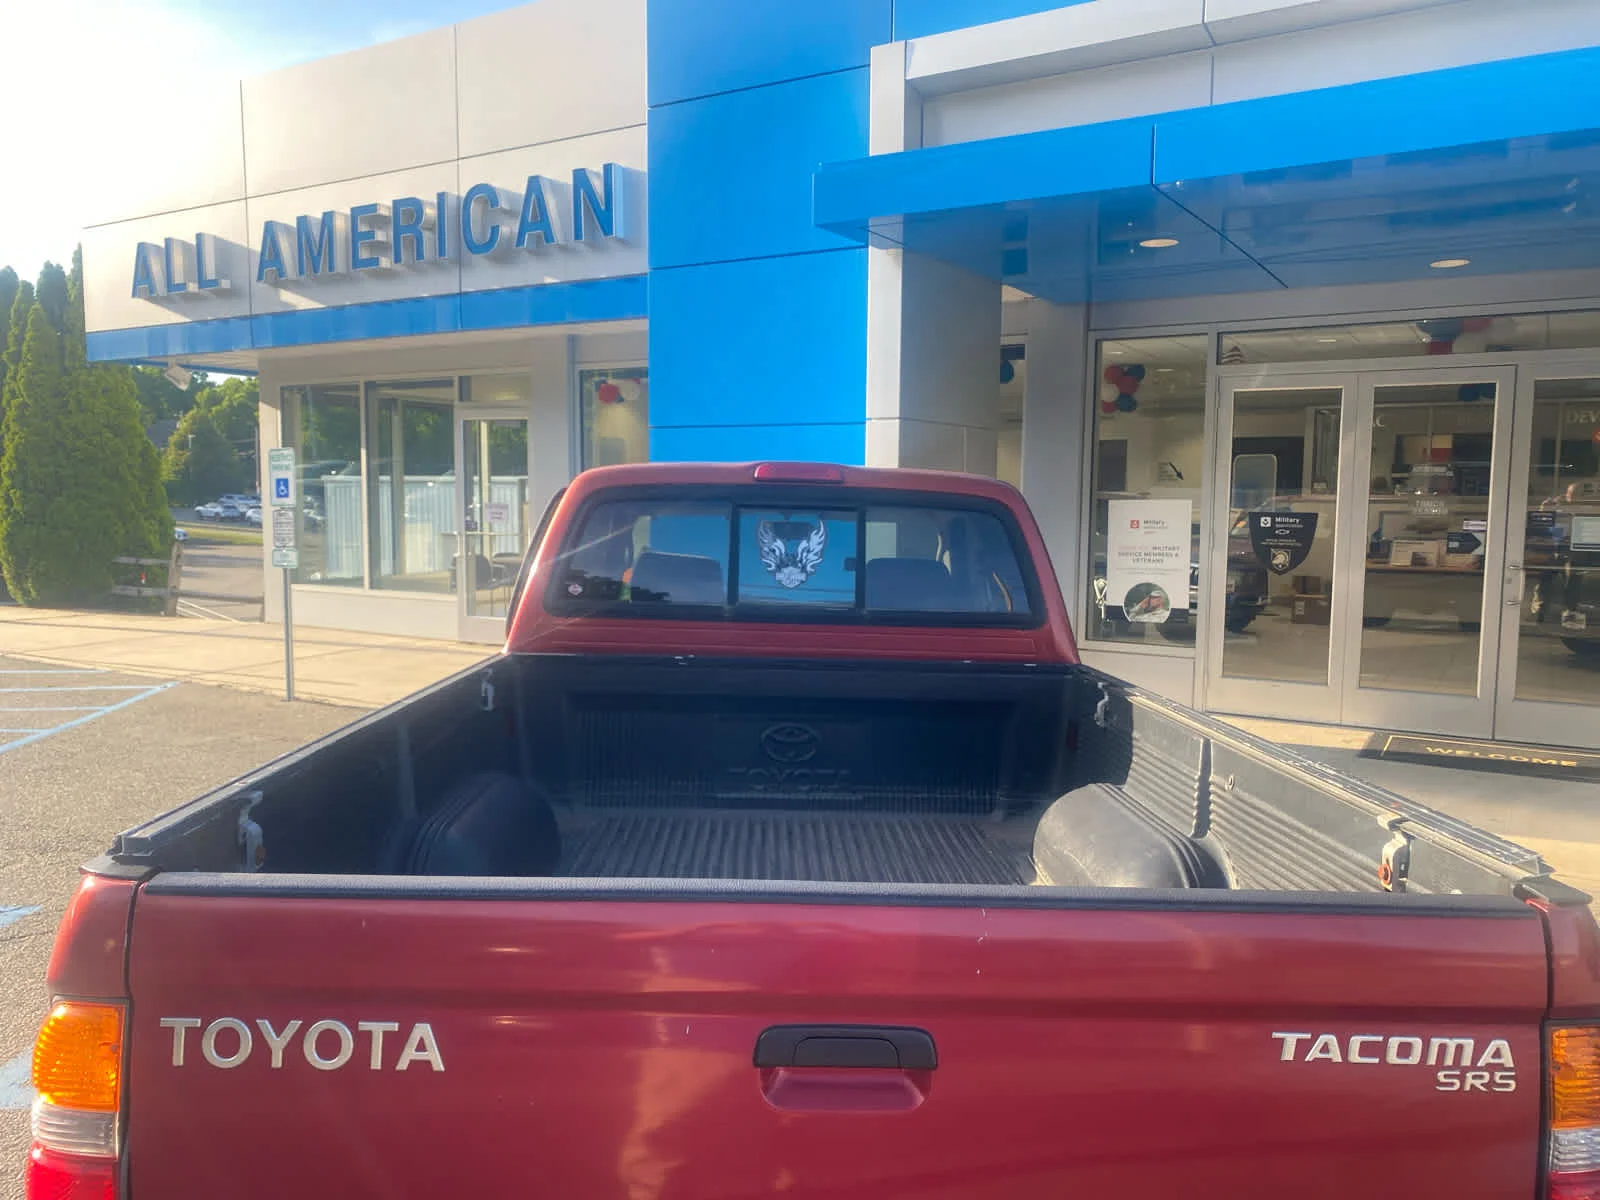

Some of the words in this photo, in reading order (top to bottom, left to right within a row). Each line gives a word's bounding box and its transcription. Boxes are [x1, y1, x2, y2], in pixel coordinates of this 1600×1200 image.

[131, 232, 224, 298] ALL
[256, 163, 618, 282] AMERICAN
[1275, 517, 1300, 525] Military
[1425, 746, 1578, 767] WELCOME
[160, 1017, 445, 1072] TOYOTA
[1271, 1031, 1515, 1068] TACOMA
